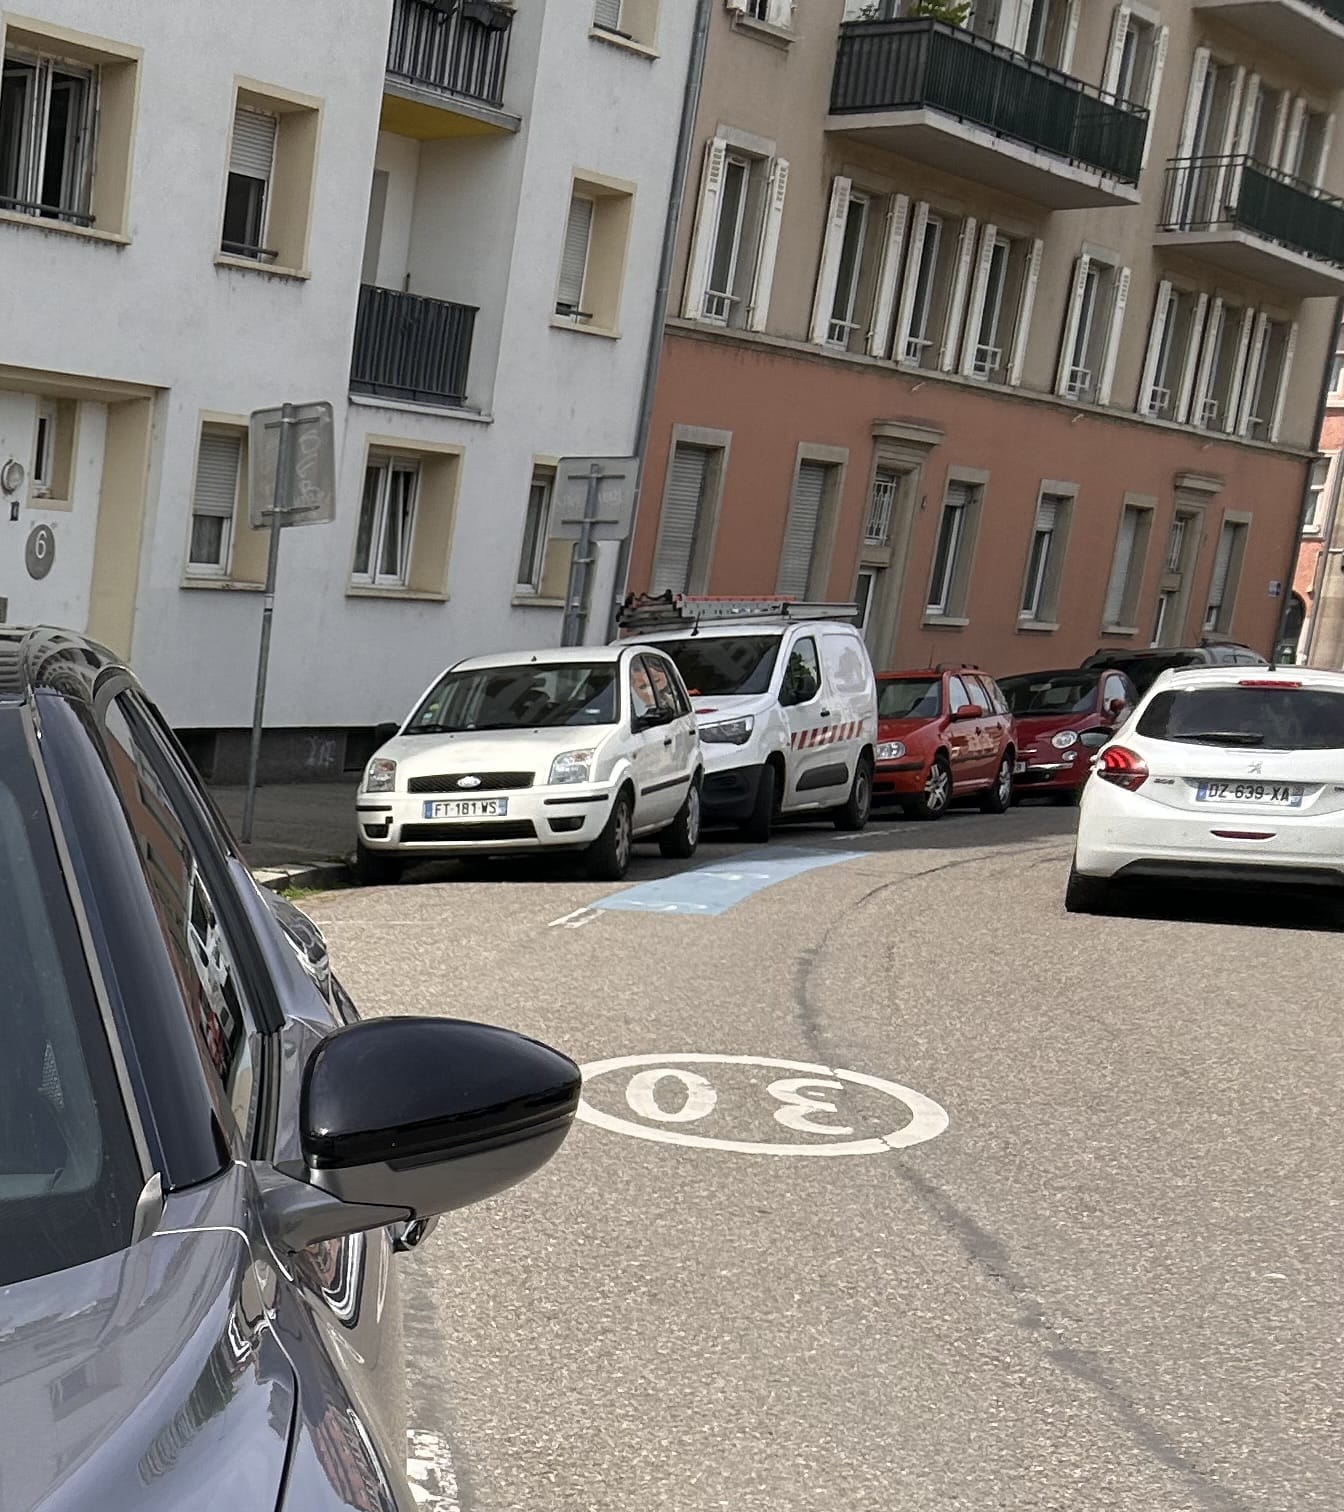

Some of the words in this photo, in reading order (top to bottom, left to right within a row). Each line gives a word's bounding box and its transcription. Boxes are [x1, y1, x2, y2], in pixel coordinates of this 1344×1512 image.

[35, 530, 47, 559] 6
[1208, 783, 1289, 801] DZ-639-XA
[625, 1068, 854, 1135] 30
